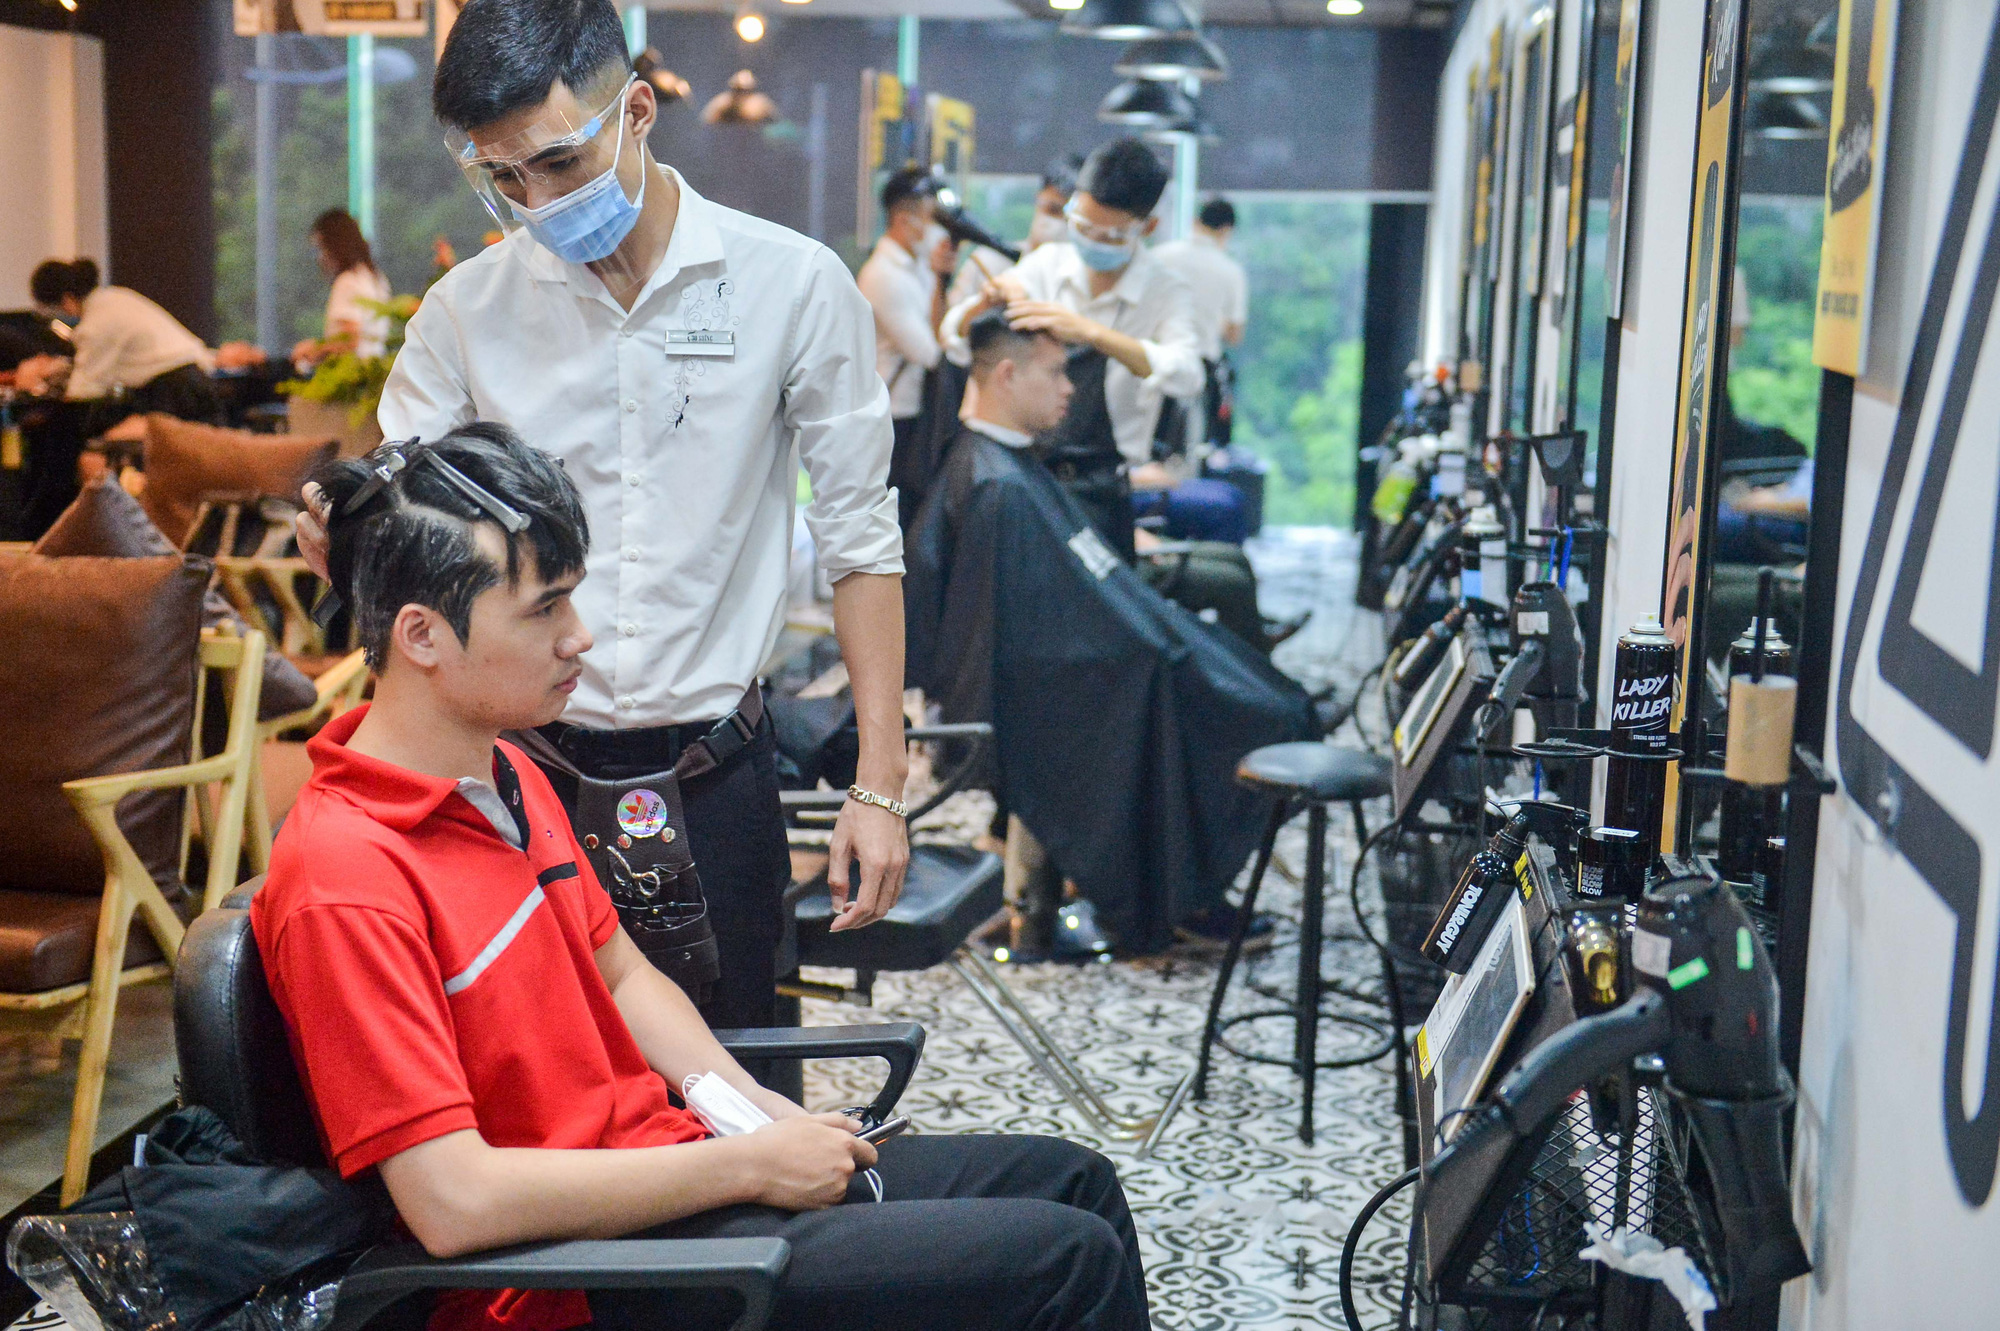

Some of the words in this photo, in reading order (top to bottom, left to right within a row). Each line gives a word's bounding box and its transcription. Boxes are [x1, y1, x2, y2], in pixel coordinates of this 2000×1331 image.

[1619, 674, 1669, 697] LADY
[1613, 696, 1671, 721] KILLER
[645, 801, 660, 831] adidas
[1581, 886, 1602, 896] GLOW
[1436, 884, 1484, 955] TONI&GUY
